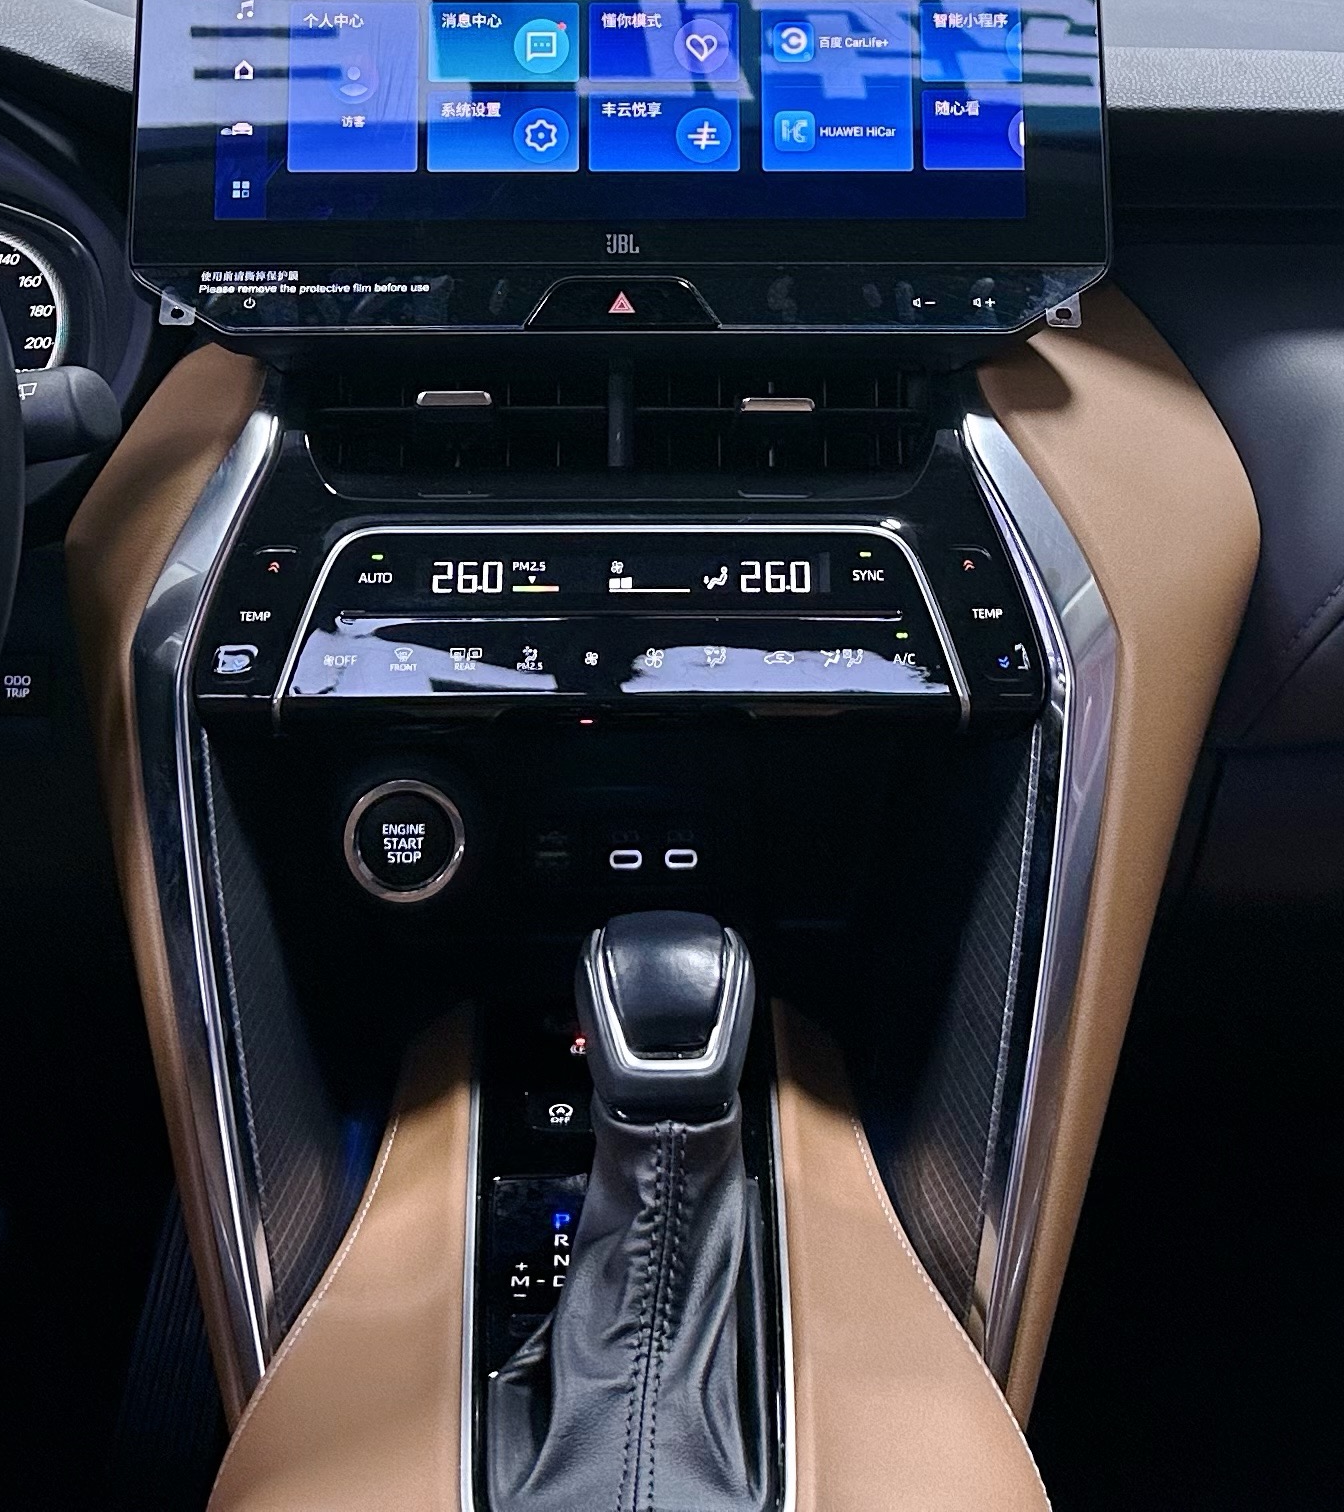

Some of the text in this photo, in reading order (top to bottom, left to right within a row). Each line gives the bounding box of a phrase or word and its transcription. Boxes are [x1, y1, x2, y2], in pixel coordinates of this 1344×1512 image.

[302, 12, 364, 29] 个人中心
[441, 12, 502, 29] 消息中心
[601, 12, 662, 29] 懂你模式
[932, 12, 1009, 29] 智能小程序
[818, 36, 890, 49] 百度 CarLife+
[441, 102, 502, 118] 系统设置
[601, 102, 662, 118] 丰云悦享
[934, 100, 980, 116] 随心看
[341, 115, 366, 128] 访客
[819, 126, 897, 138] HUAWEI HiCar
[607, 234, 640, 255] JBL
[19, 275, 42, 288] 160
[199, 283, 430, 295] Please remove the protective film before use
[29, 304, 53, 317] 180
[24, 337, 51, 350] 200
[358, 573, 393, 584] AUTO
[432, 561, 546, 594] 26.0 PM2.5
[740, 561, 810, 594] 26.0
[852, 569, 885, 582] SYNC
[239, 611, 271, 623] TEMP
[972, 608, 1003, 620] TEMP
[334, 655, 357, 667] OFF
[893, 652, 916, 667] A/C
[389, 663, 417, 672] FRONT
[454, 662, 476, 671] REAR
[516, 662, 543, 671] PM2.5
[4, 675, 31, 686] ODO
[6, 687, 30, 698] TRIP
[382, 823, 425, 836] ENGINE
[383, 837, 424, 850] START
[387, 850, 422, 864] STOP
[550, 1116, 570, 1124] OFF
[555, 1213, 570, 1229] P
[553, 1233, 569, 1247] R
[553, 1254, 570, 1267] N
[510, 1276, 530, 1287] M
